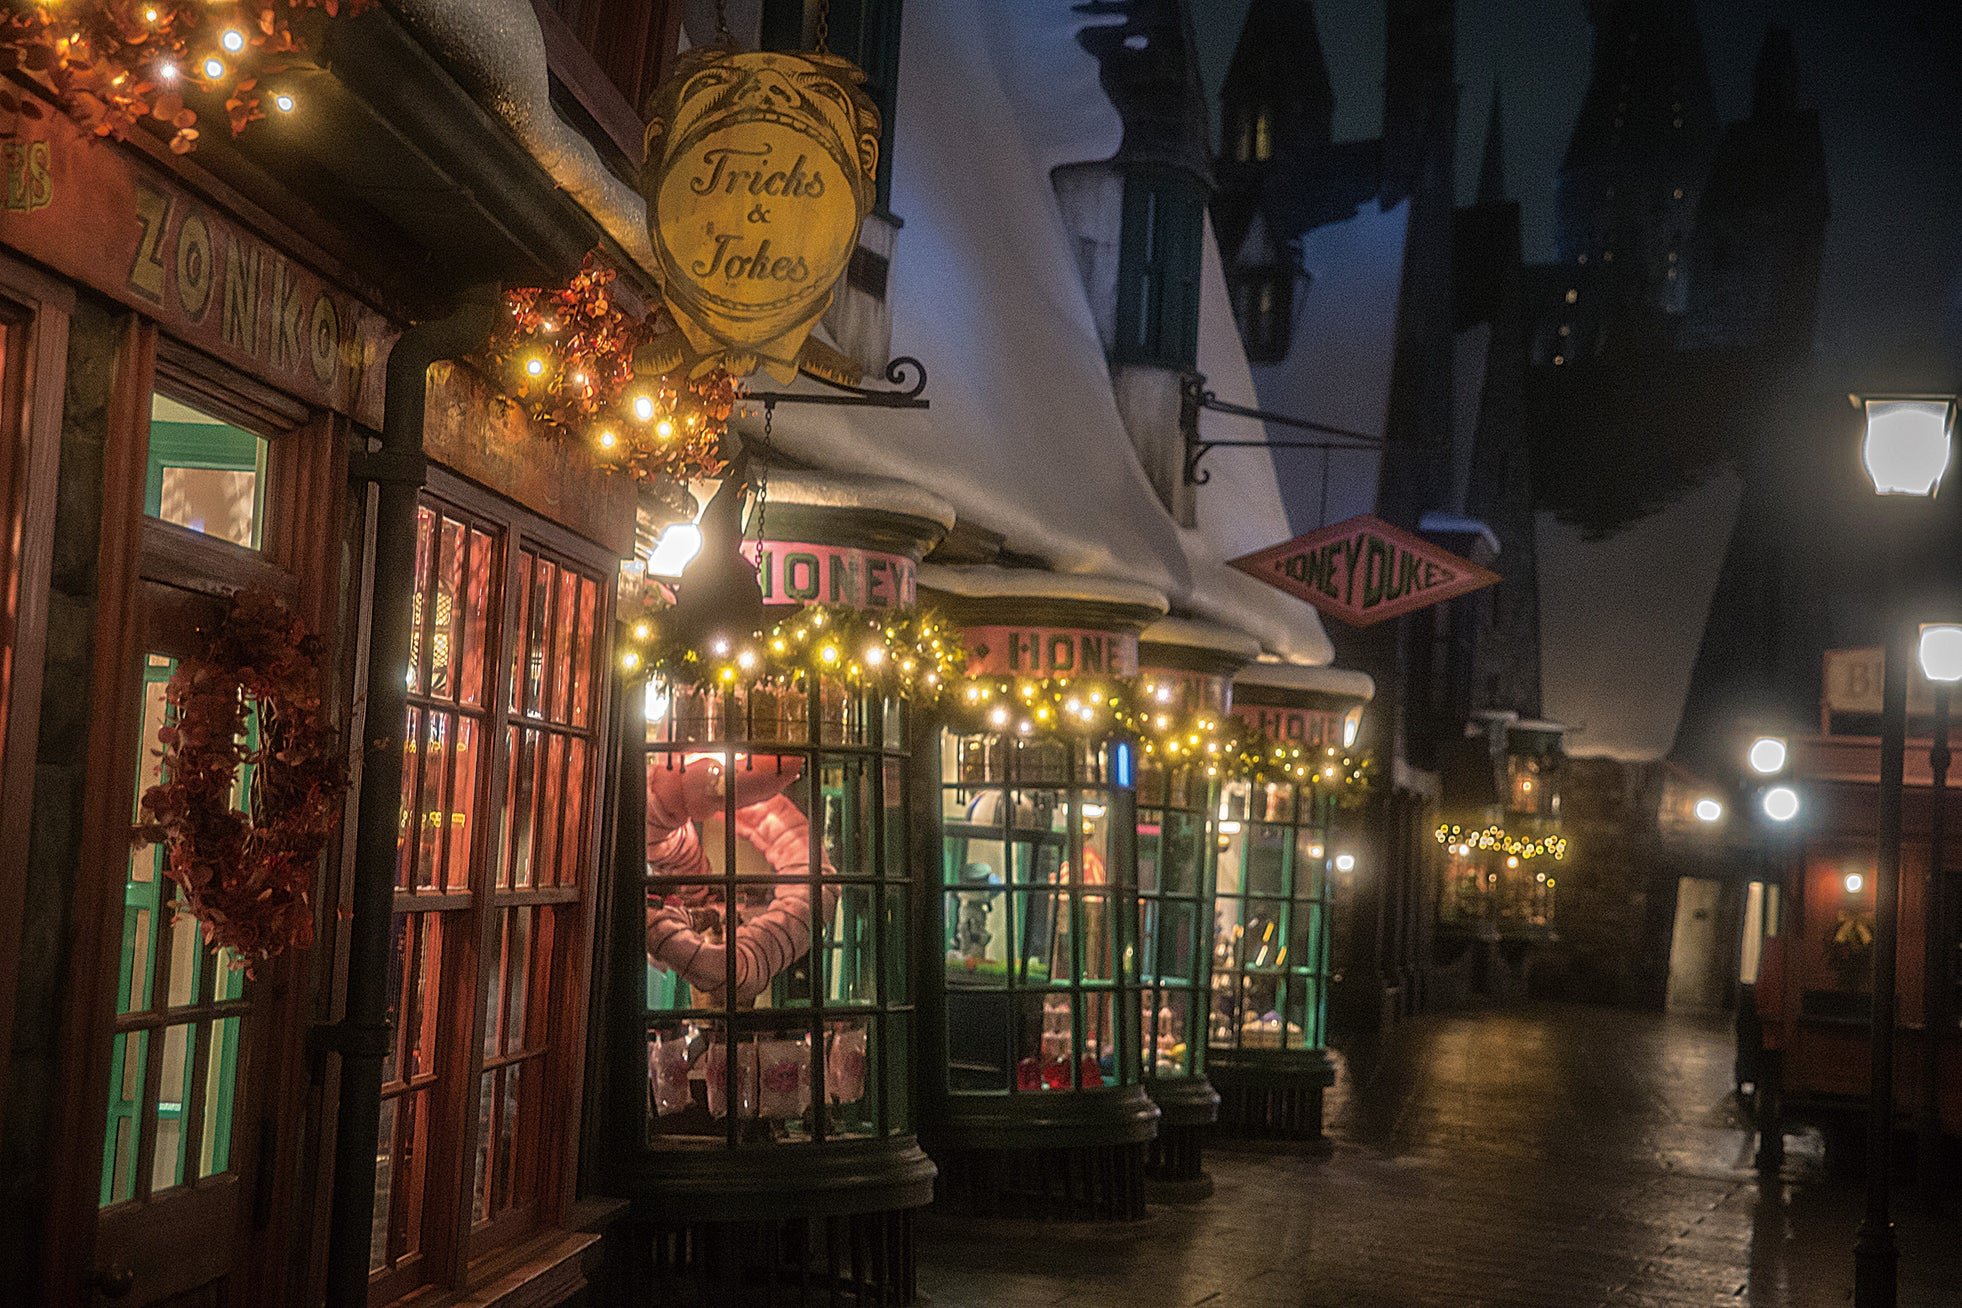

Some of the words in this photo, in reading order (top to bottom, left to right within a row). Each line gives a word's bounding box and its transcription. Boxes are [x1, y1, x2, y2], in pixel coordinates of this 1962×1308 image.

[690, 143, 826, 198] Tricks
[747, 204, 771, 224] &
[691, 234, 808, 283] Jokes
